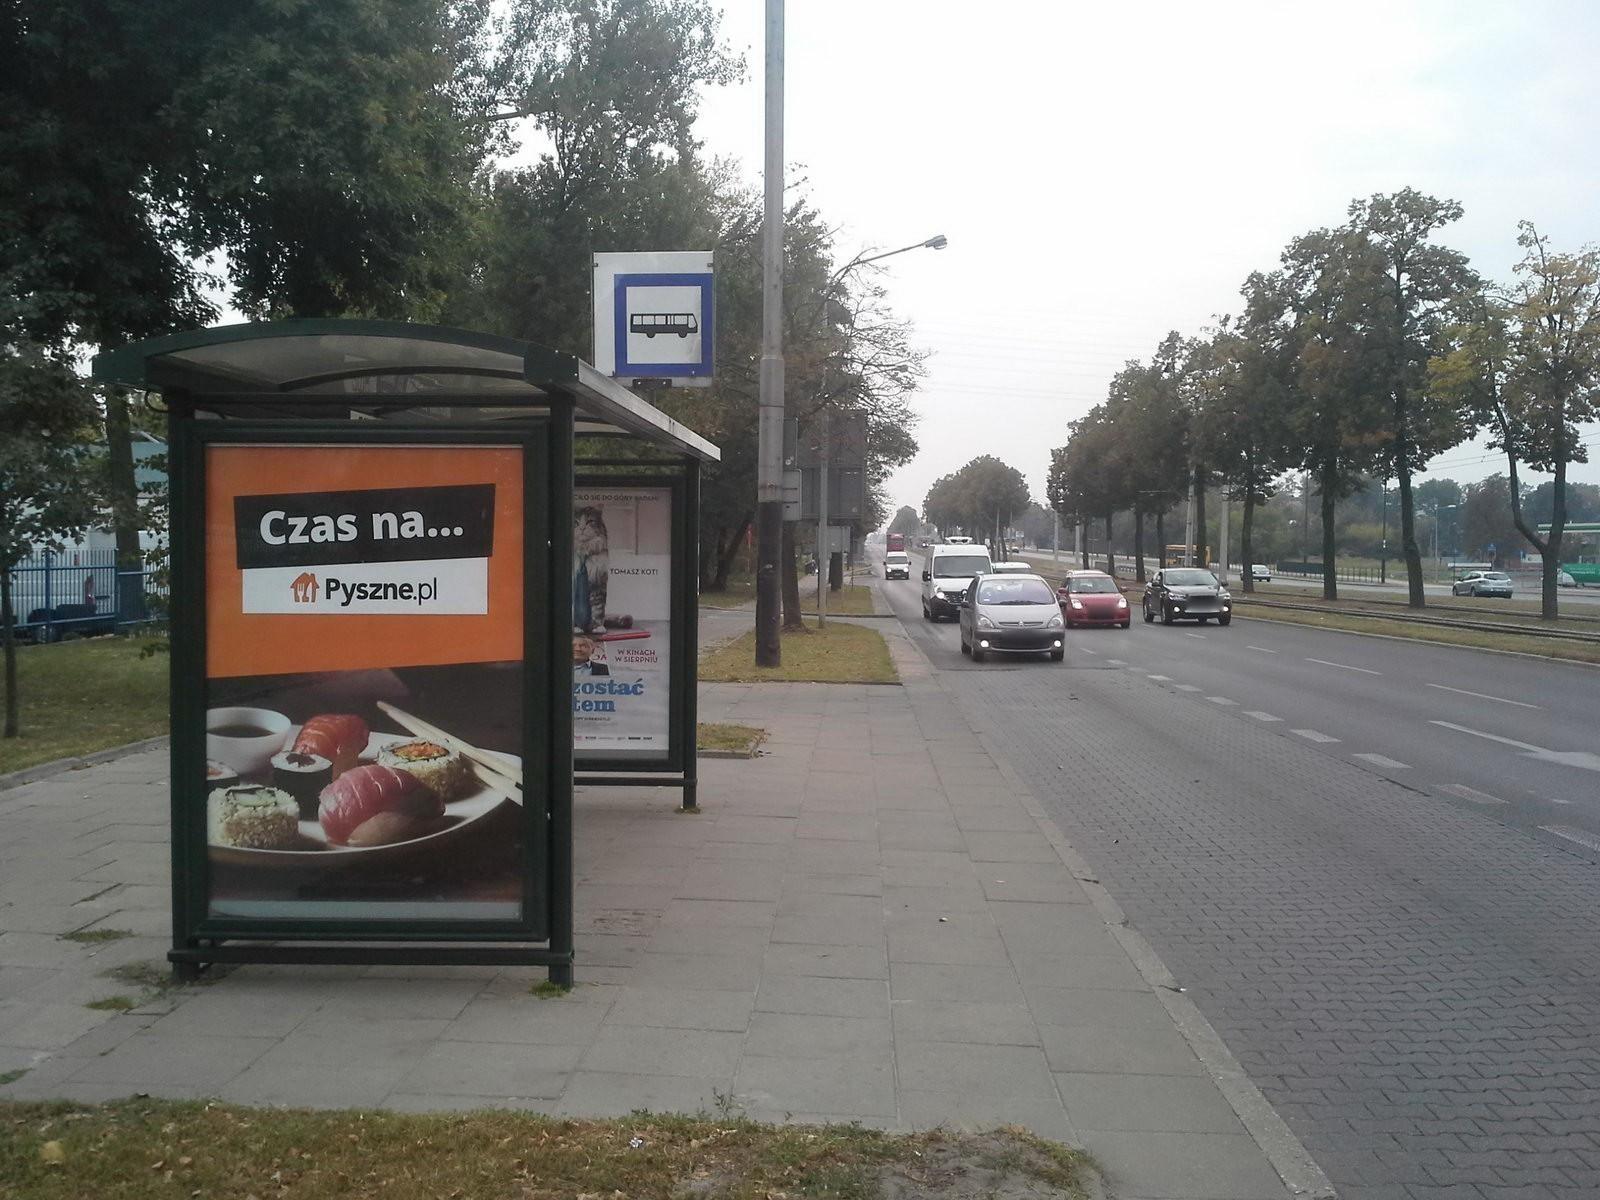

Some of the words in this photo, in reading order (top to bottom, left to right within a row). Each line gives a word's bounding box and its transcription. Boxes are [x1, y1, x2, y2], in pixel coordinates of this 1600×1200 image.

[259, 510, 358, 545] Czas
[372, 510, 464, 540] na...
[325, 577, 437, 607] Pyszne.pl
[574, 678, 644, 695] zostać
